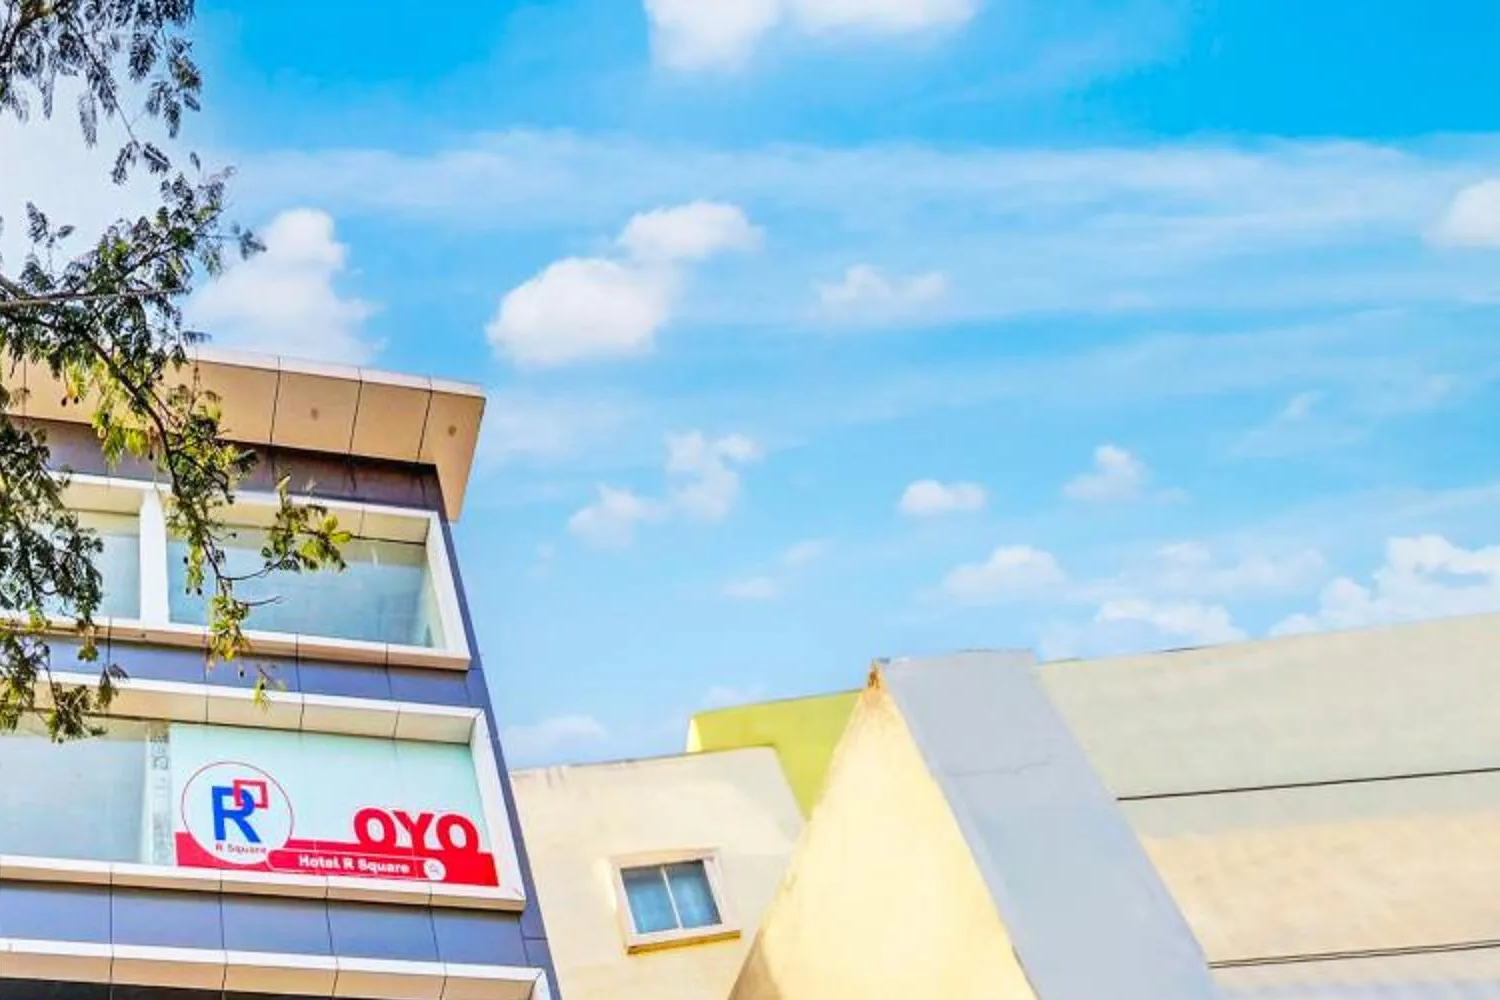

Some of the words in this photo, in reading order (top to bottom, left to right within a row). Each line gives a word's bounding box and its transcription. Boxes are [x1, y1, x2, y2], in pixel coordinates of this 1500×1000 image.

[353, 806, 480, 853] OYO
[227, 843, 267, 855] Square
[299, 854, 340, 869] Hotel
[343, 858, 354, 871] R
[357, 858, 410, 874] Square
